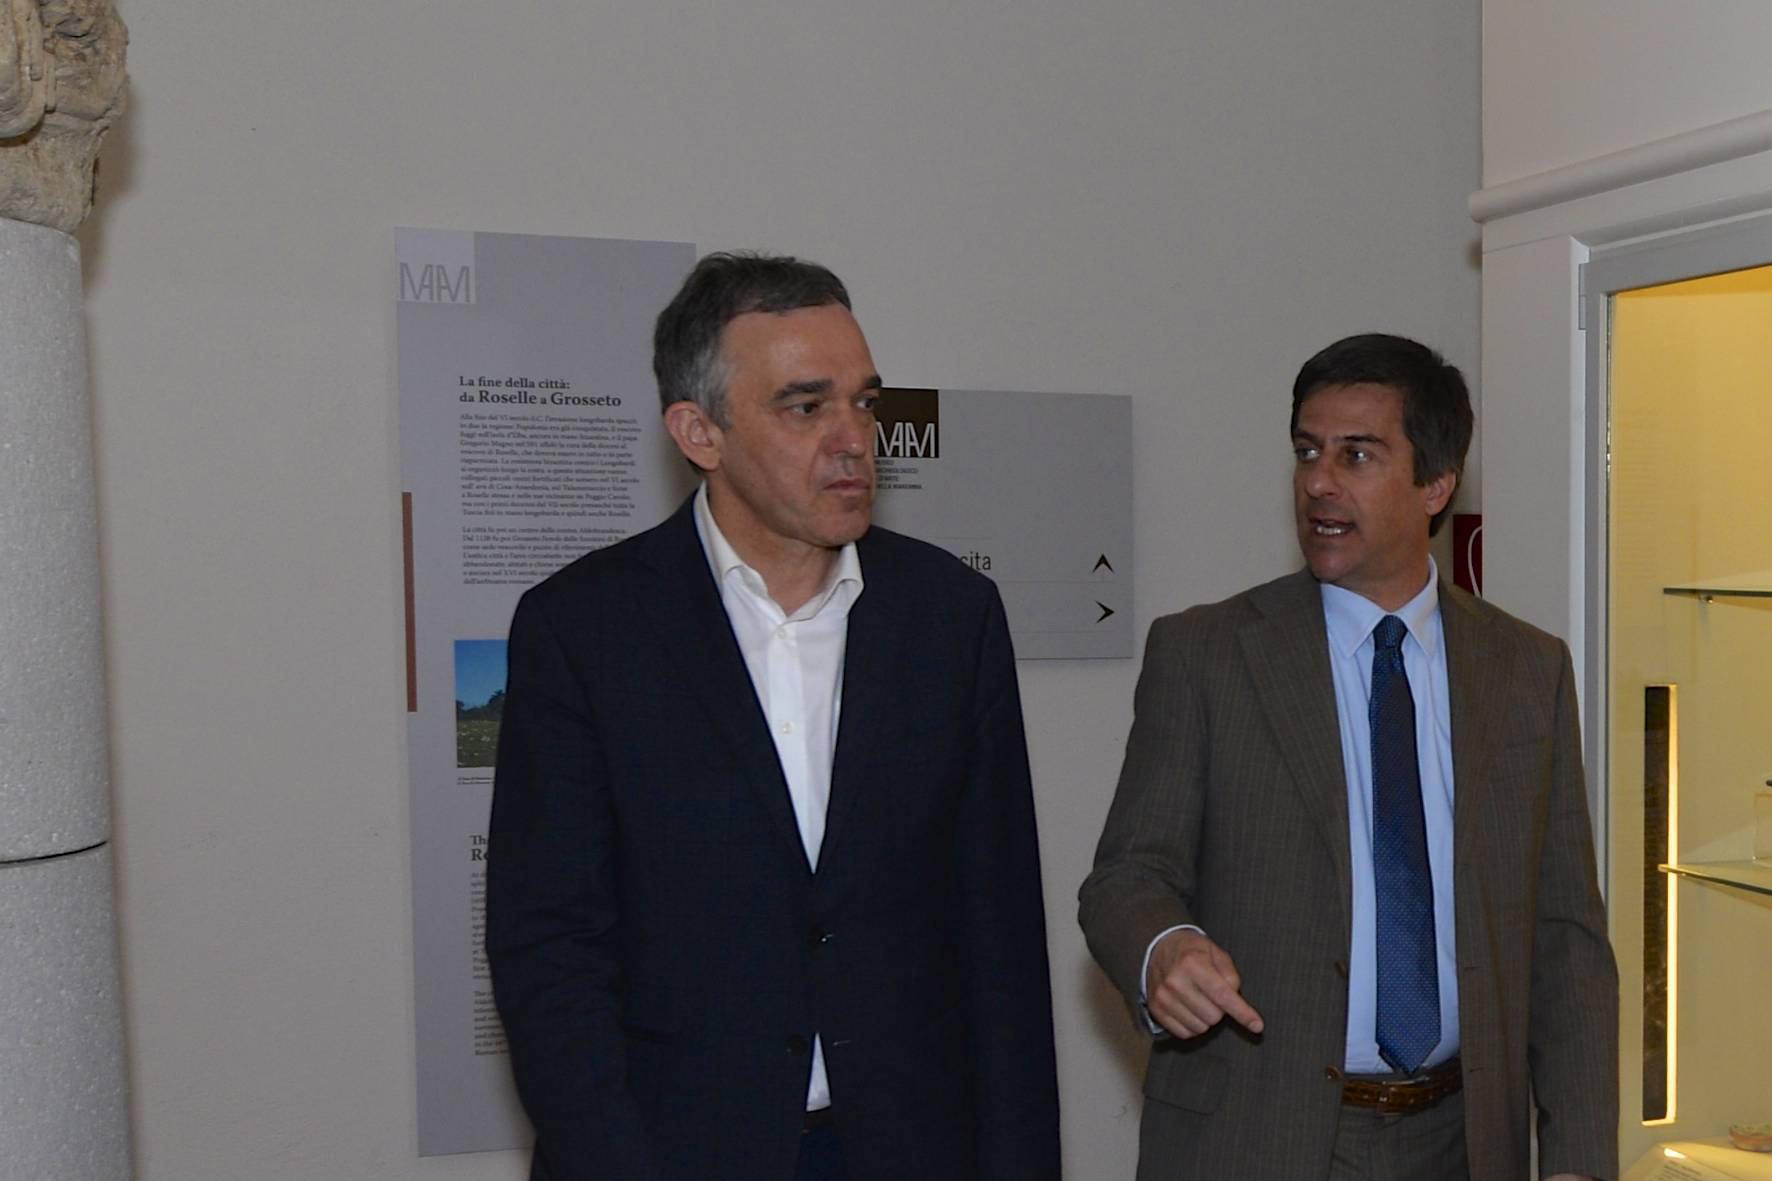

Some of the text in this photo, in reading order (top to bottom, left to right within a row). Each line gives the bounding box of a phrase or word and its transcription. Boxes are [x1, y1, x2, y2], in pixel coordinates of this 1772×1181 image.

[459, 376, 571, 390] La fine della città:
[459, 390, 622, 407] da Roselle a Grosseto
[469, 834, 488, 845] Th
